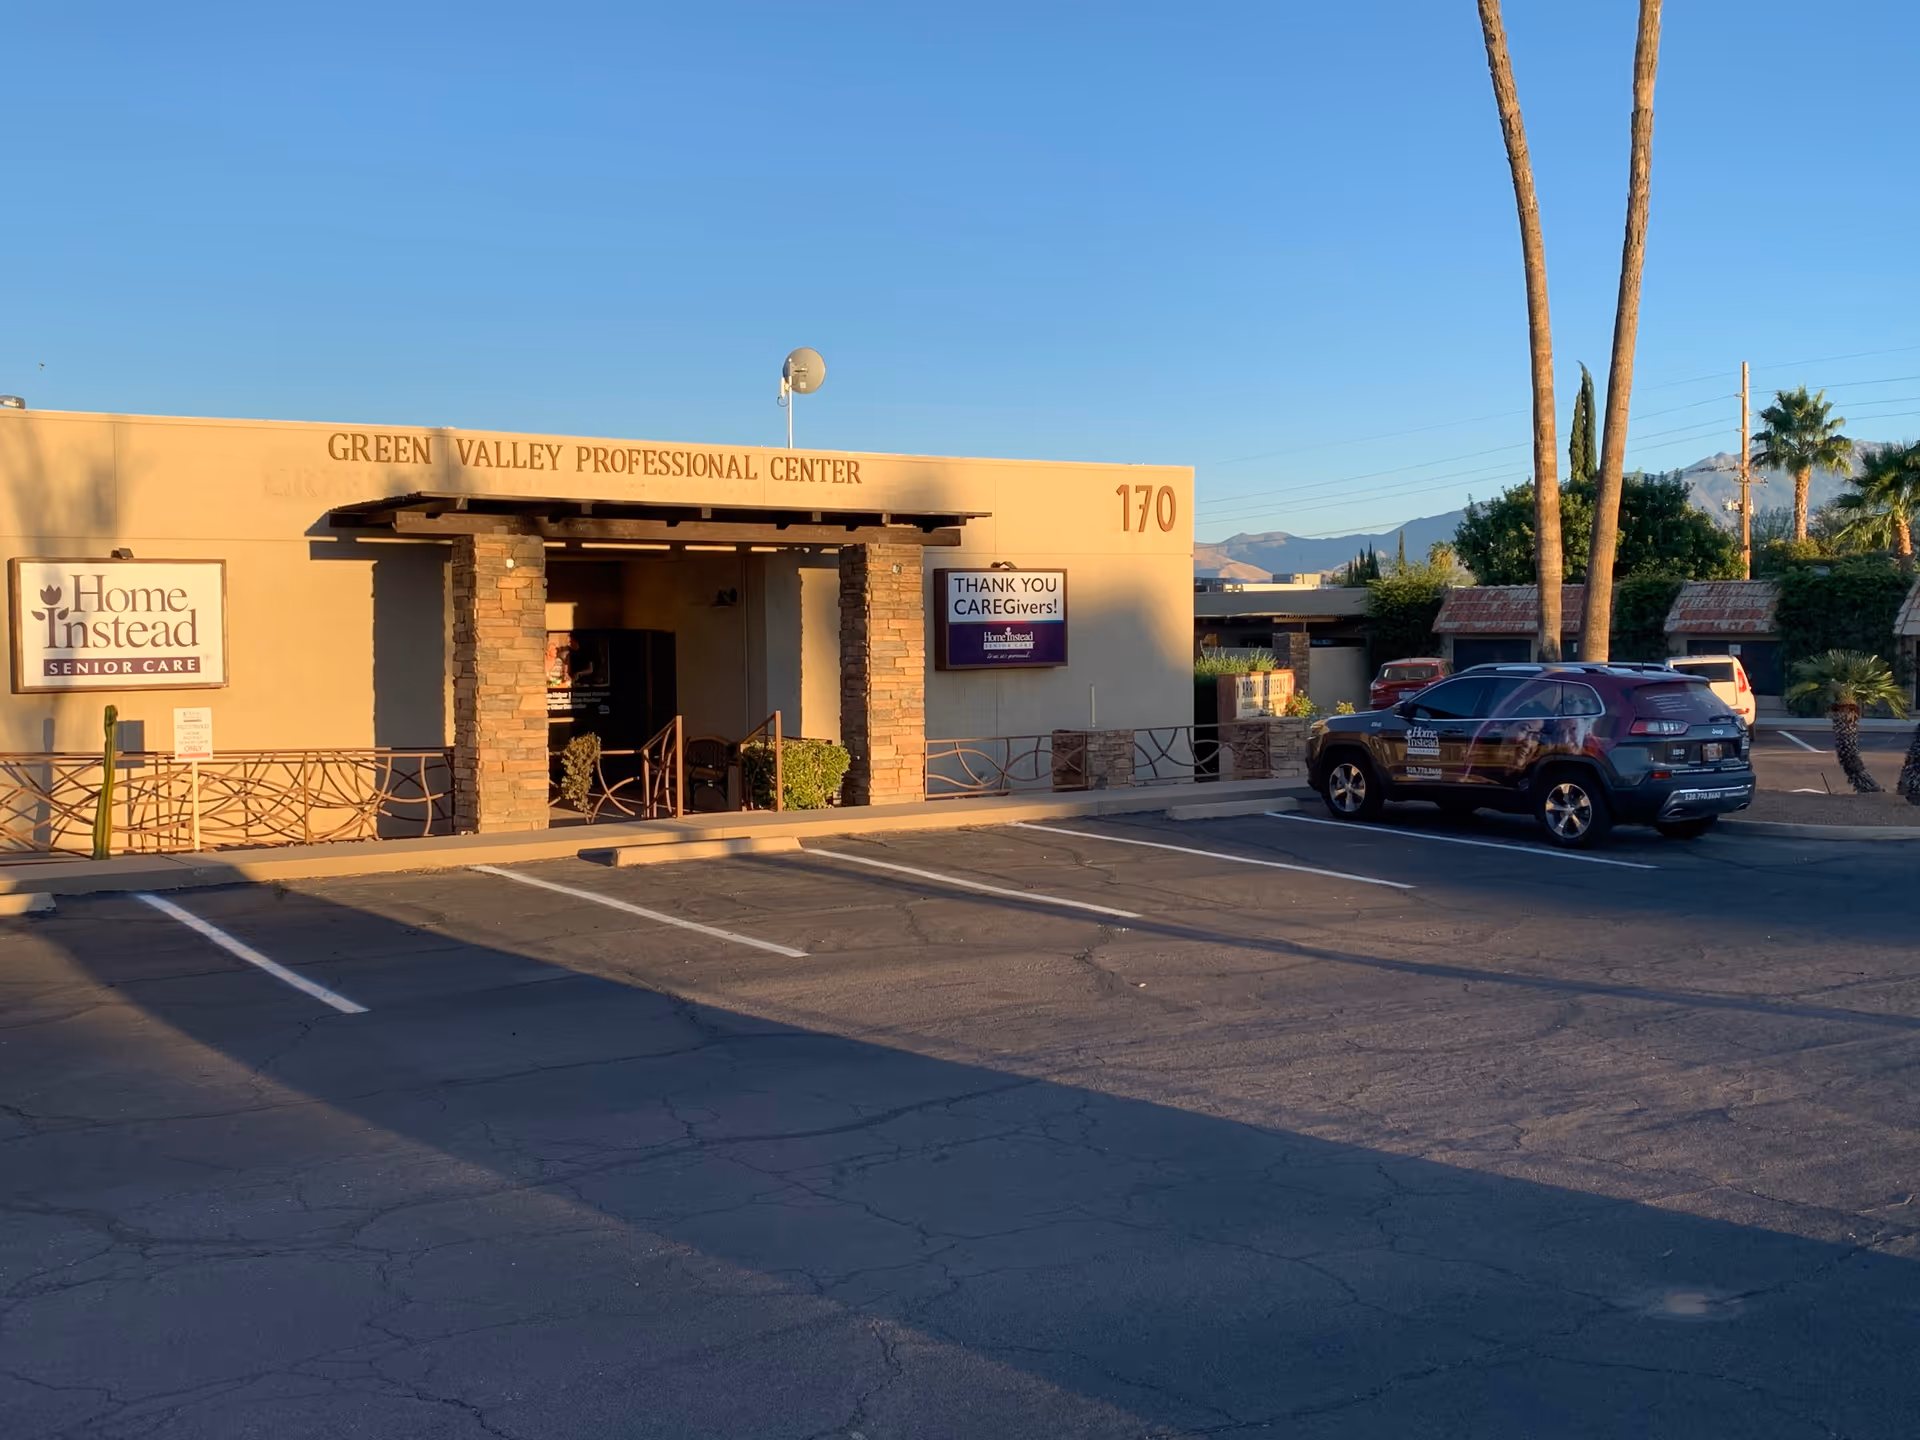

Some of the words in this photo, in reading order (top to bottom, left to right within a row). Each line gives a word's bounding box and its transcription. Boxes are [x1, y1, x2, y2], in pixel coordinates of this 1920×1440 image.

[328, 433, 432, 464] GREEN
[456, 438, 563, 471] VALLEY
[576, 446, 758, 481] PROFESSIONAL
[770, 456, 862, 484] CENTER
[1116, 484, 1176, 532] 170
[953, 577, 1016, 592] THANK
[1021, 577, 1057, 592] YOU
[69, 574, 188, 612] Home
[954, 598, 1057, 615] CAREGivers!
[43, 607, 200, 649] Instead
[983, 631, 1005, 641] Home
[1006, 630, 1033, 641] Instead
[49, 660, 133, 675] SENIOR
[143, 659, 196, 672] CARE
[1411, 726, 1438, 738] Home
[1407, 736, 1439, 748] Instead
